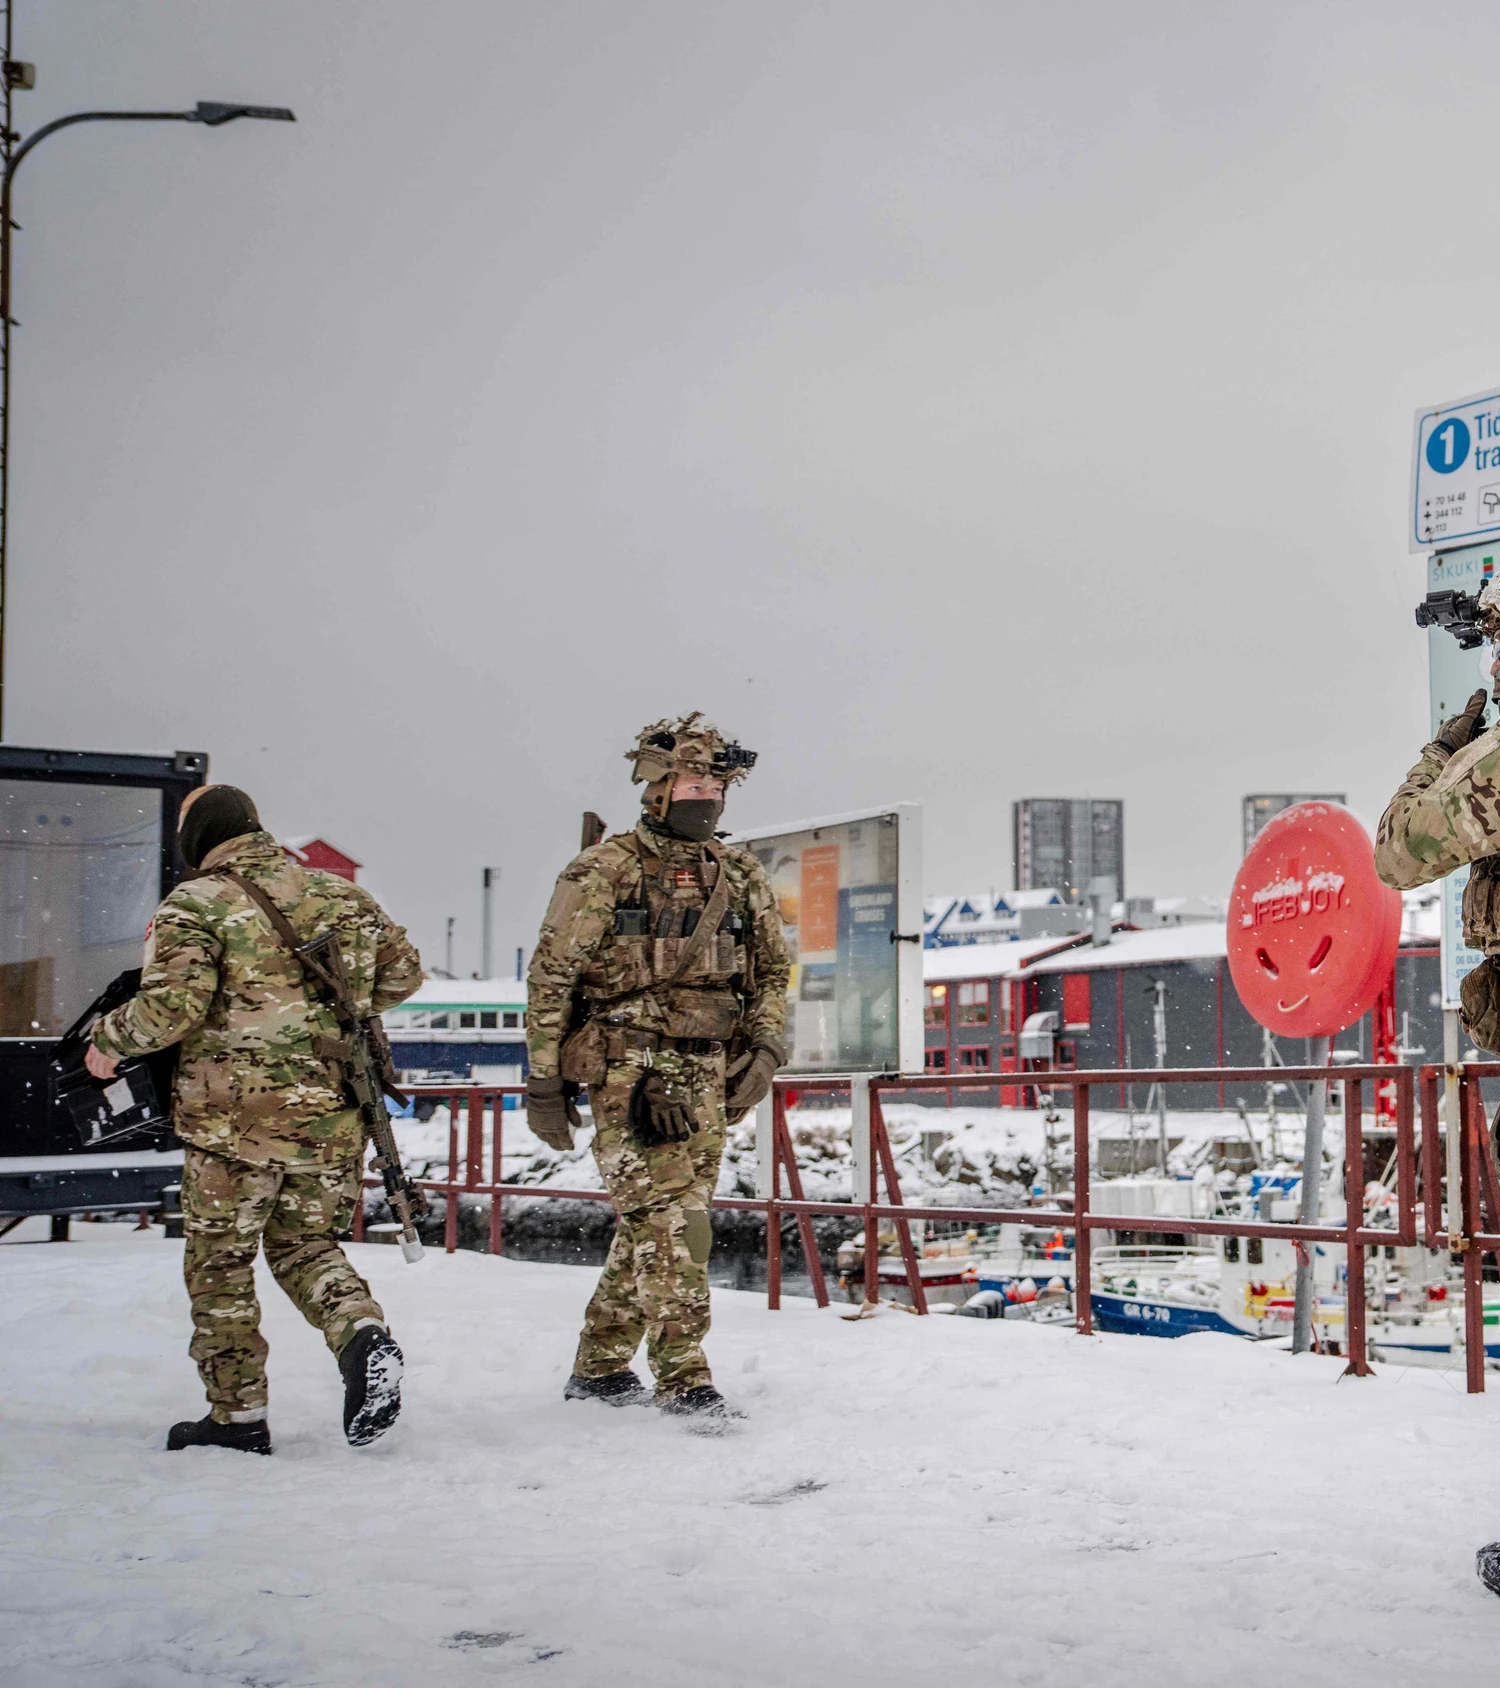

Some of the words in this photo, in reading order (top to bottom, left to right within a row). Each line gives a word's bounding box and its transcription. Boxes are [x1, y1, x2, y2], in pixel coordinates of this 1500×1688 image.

[1440, 424, 1455, 465] 1
[1451, 506, 1463, 516] 112
[1435, 522, 1447, 533] 113
[1432, 559, 1478, 582] SIKUKI
